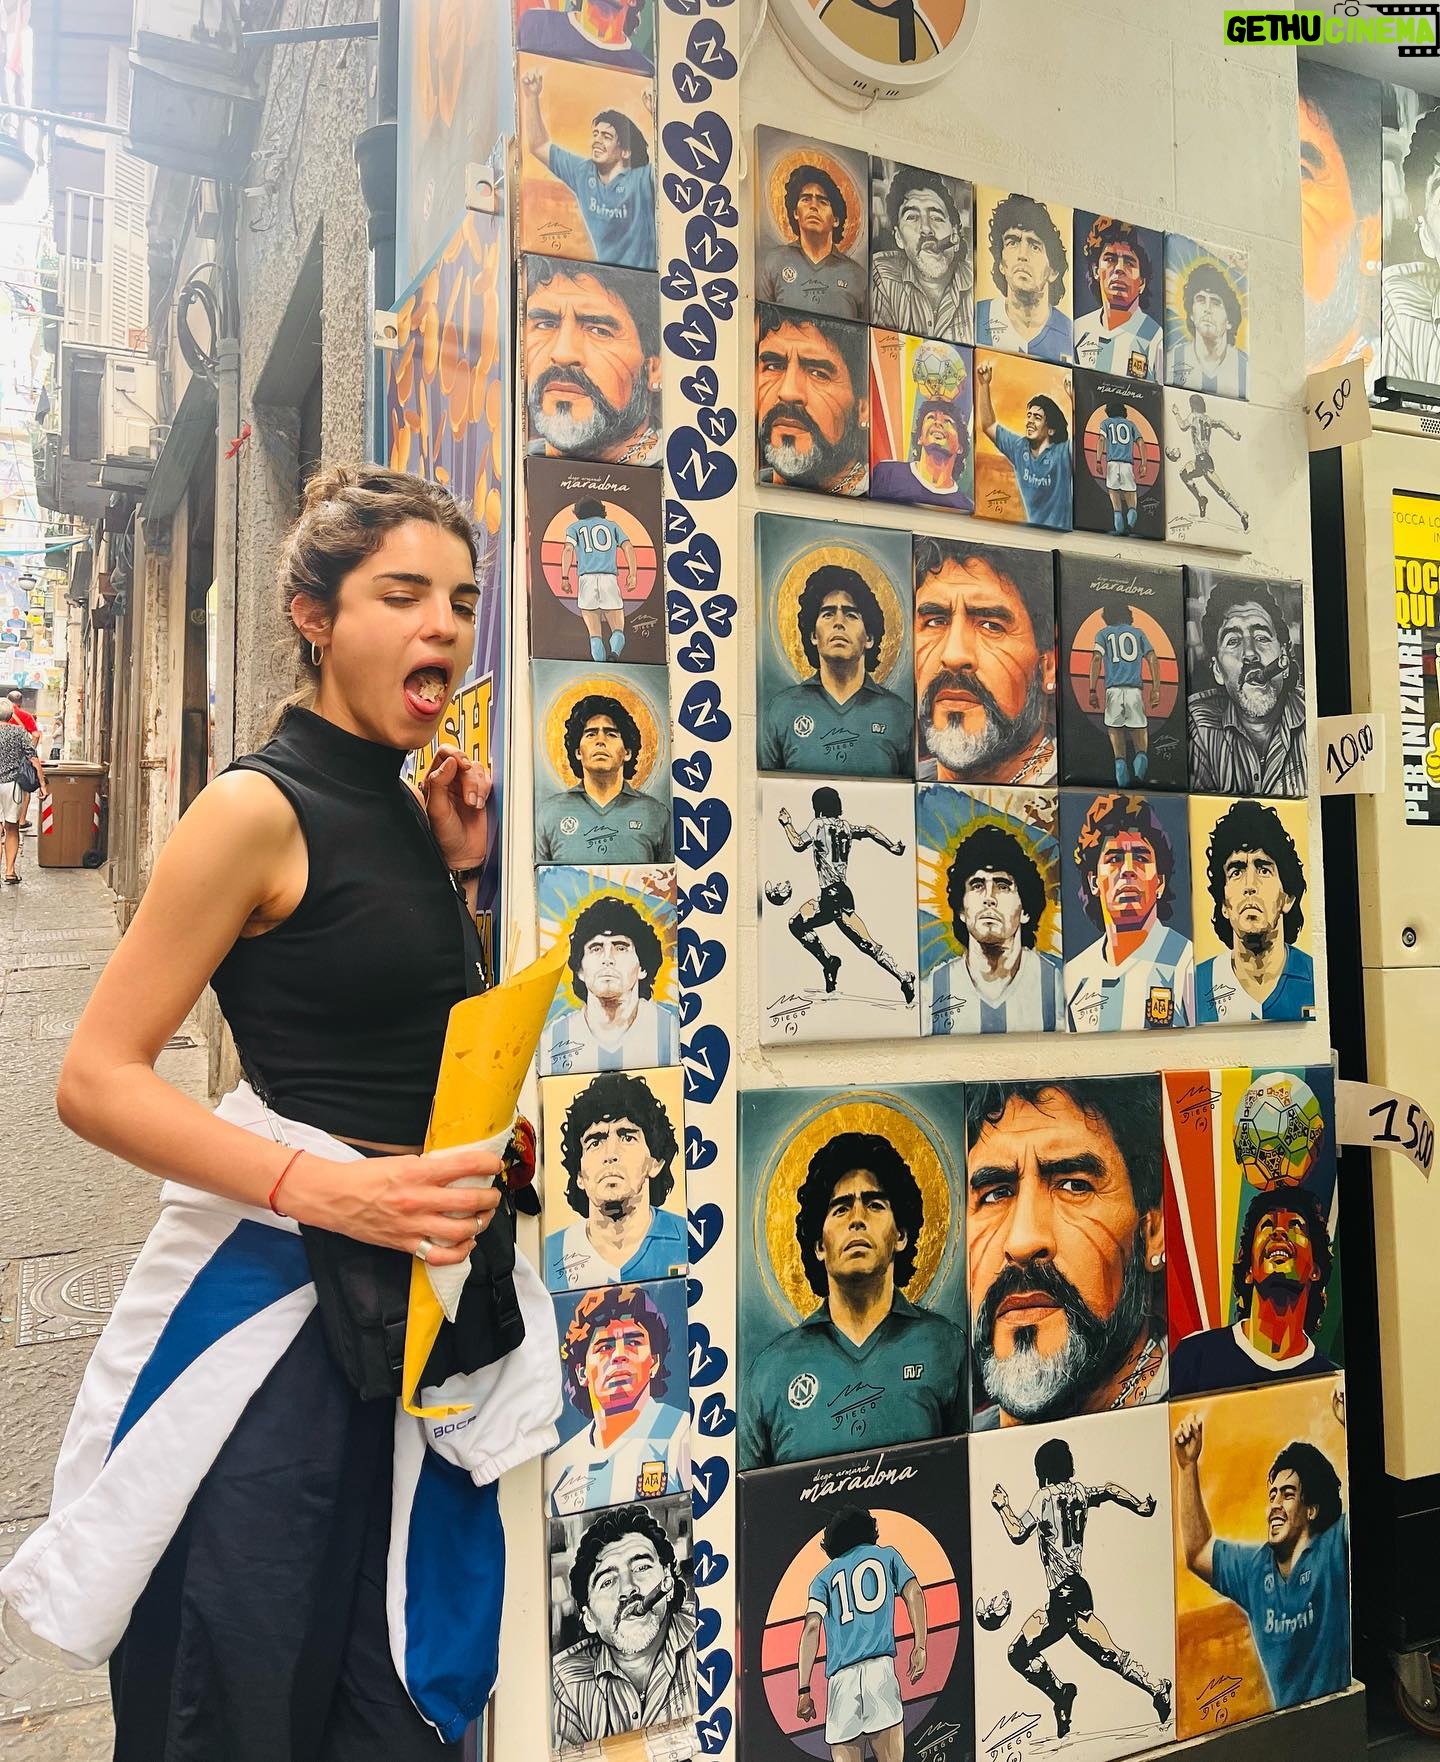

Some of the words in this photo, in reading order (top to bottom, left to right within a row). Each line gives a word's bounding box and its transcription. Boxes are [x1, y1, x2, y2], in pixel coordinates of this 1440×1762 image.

[693, 36, 723, 63] N
[680, 74, 700, 98] N
[683, 131, 720, 170] N
[675, 183, 691, 205] N
[708, 197, 729, 216] N
[691, 232, 723, 265] N
[670, 271, 692, 295] N
[709, 285, 728, 308] N
[680, 320, 710, 355] N
[691, 377, 714, 401] N
[1097, 384, 1144, 399] maradona
[709, 417, 725, 436] N
[1108, 423, 1130, 444] 10
[560, 474, 630, 492] maradona
[677, 447, 717, 492] N
[669, 512, 687, 533] N
[579, 524, 612, 553] 10
[683, 550, 714, 585] N
[1090, 577, 1156, 596] maradona
[671, 603, 691, 626] N
[708, 602, 728, 625] N
[1396, 592, 1435, 628] QUI
[688, 643, 711, 669] N
[1107, 632, 1138, 663] 10
[1398, 628, 1427, 756] INIZIARE
[688, 698, 717, 727] N
[683, 762, 704, 785] N
[1404, 764, 1429, 820] PER
[679, 816, 710, 852] N
[701, 883, 722, 910] N
[679, 944, 710, 978] N
[770, 1011, 806, 1028] DIEGO
[681, 1046, 715, 1092] N
[1181, 1104, 1215, 1124] DIEGO
[703, 1404, 726, 1431] N
[832, 1402, 876, 1430] DIEGO
[800, 1453, 918, 1503] maradona
[813, 1469, 832, 1488] diego
[836, 1460, 871, 1477] armando
[694, 1553, 717, 1581] N
[831, 1558, 887, 1625] 10
[1200, 1691, 1236, 1720] DIEGO
[702, 1720, 724, 1749] N
[991, 1731, 1032, 1762] DIEGO
